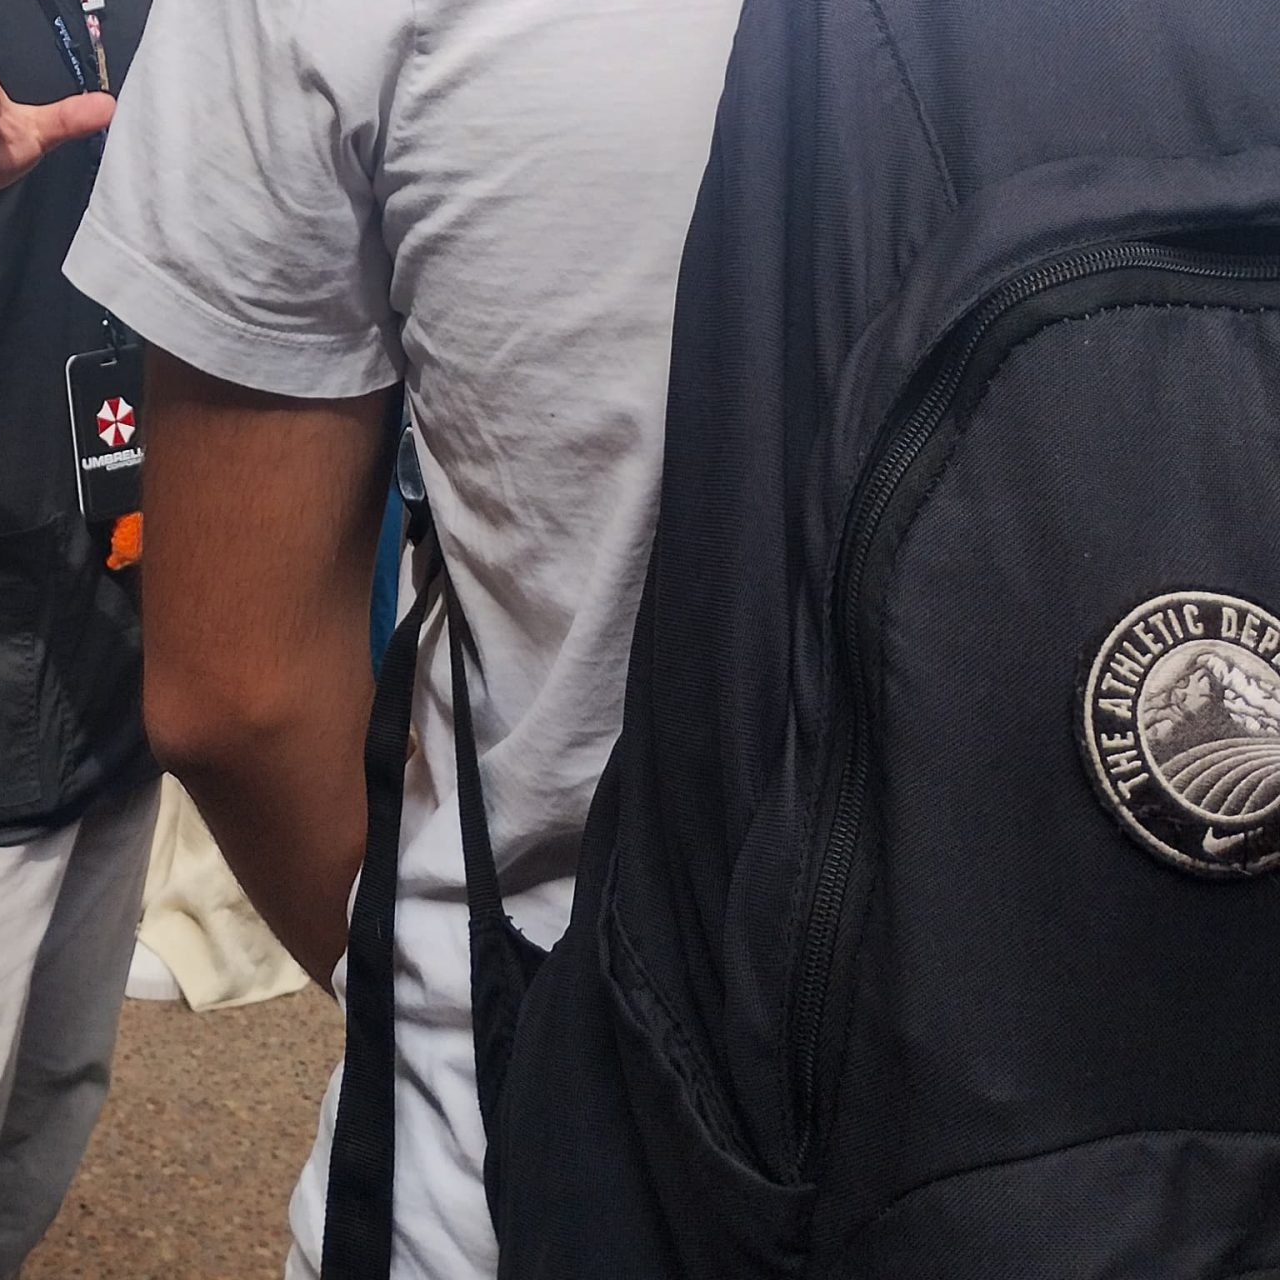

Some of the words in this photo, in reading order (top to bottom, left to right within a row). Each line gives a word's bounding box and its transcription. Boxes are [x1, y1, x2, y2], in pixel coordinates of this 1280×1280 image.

[81, 447, 144, 470] UMBRELL
[1098, 603, 1205, 719] ATHLETIC
[1100, 730, 1150, 800] THE
